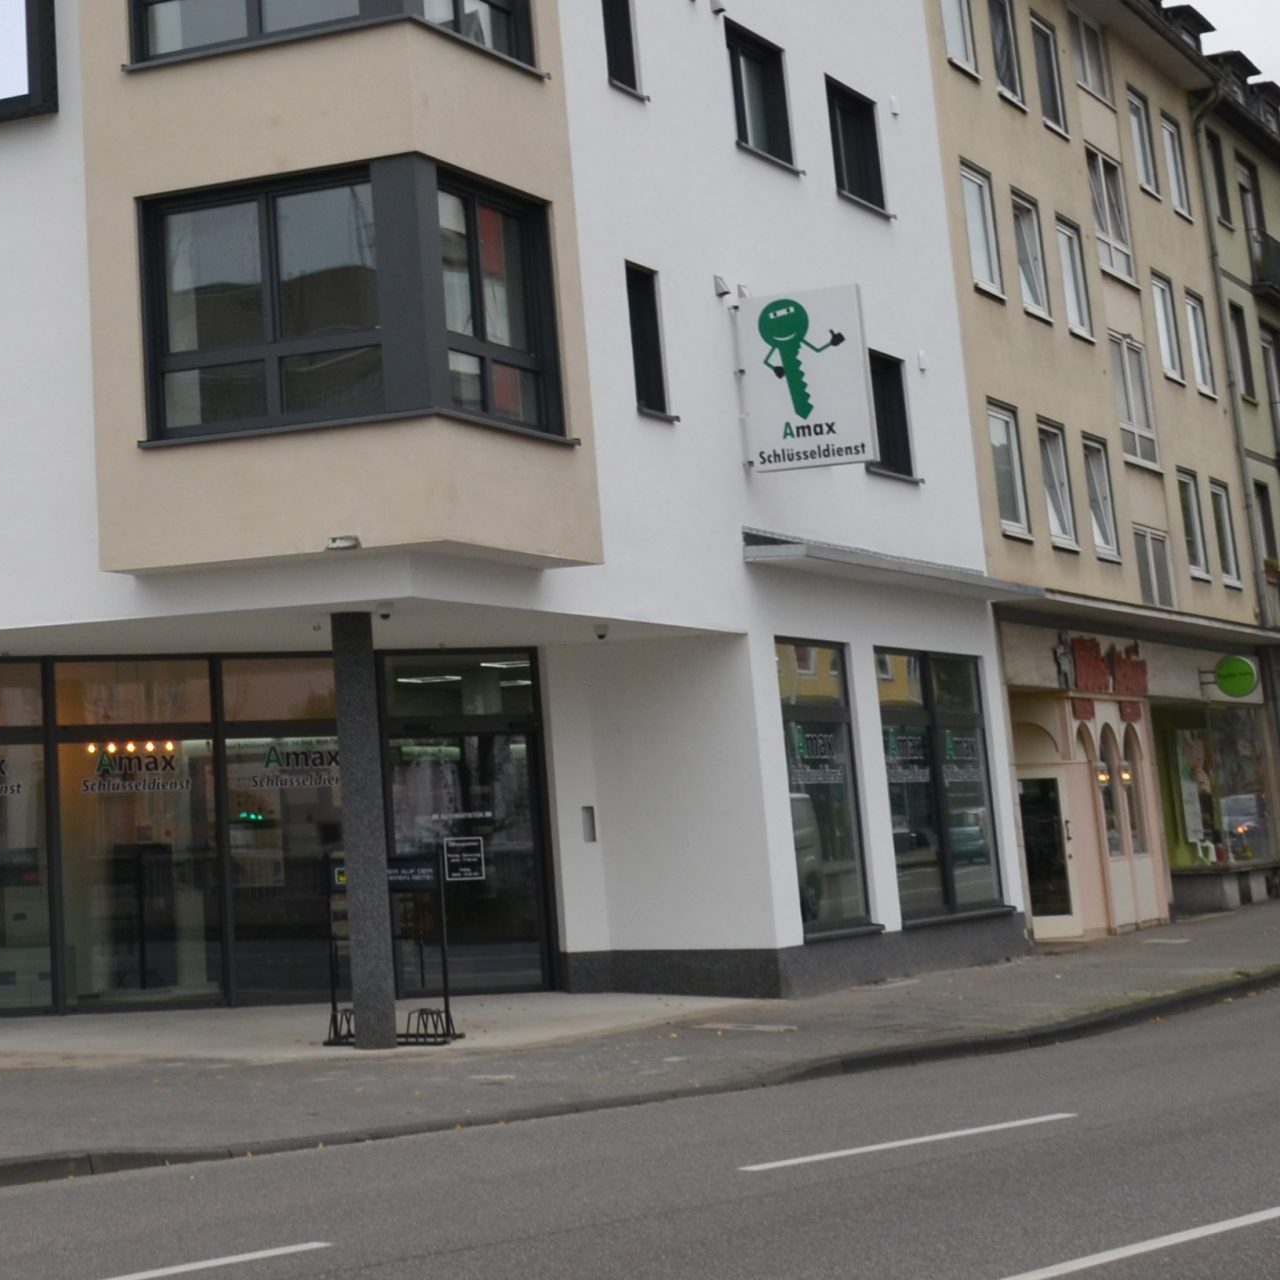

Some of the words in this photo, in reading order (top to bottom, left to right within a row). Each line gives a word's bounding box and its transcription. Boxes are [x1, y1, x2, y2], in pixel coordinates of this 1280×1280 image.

[782, 421, 837, 440] Amax
[759, 442, 866, 465] Schlüsseldienst
[796, 724, 835, 760] Amax
[96, 748, 176, 773] Amax
[263, 745, 340, 768] Amax
[81, 776, 192, 793] Schlüsseldienst
